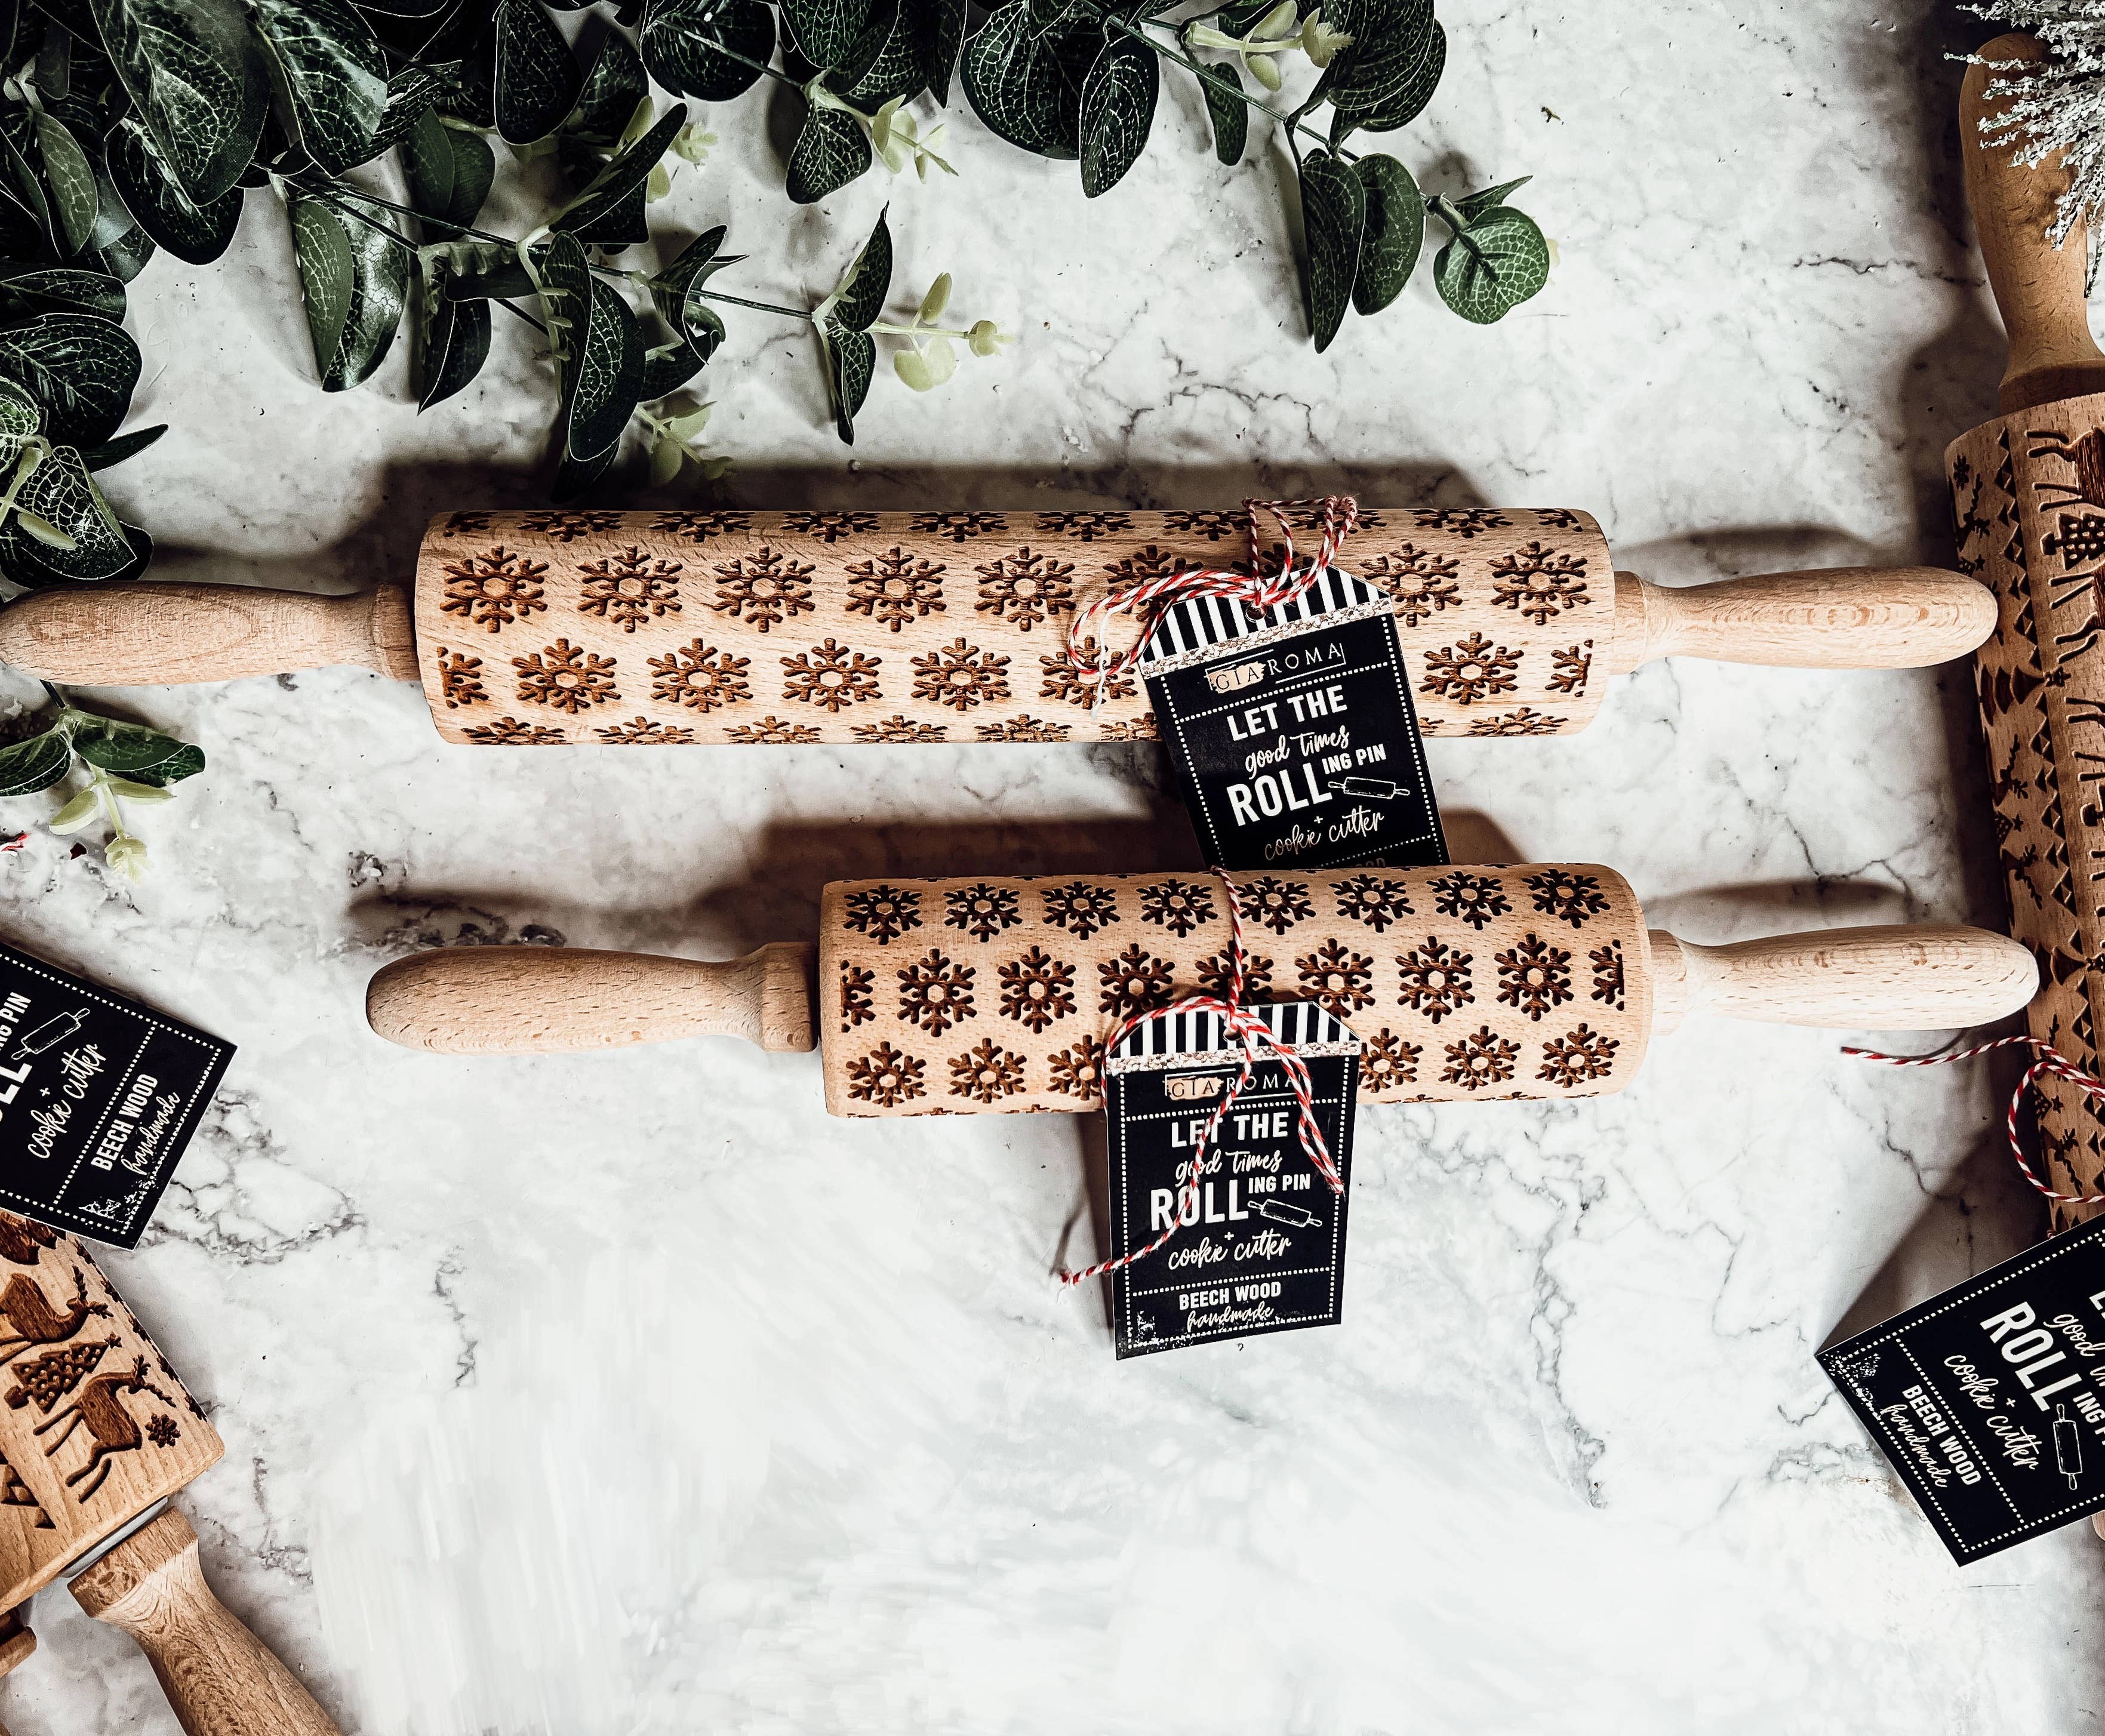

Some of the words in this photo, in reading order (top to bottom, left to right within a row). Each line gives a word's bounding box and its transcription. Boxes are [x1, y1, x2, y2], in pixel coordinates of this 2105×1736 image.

[1215, 643, 1342, 690] GIAROMA
[1227, 702, 1278, 741] LET
[1287, 685, 1347, 722] THE
[1245, 735, 1290, 780] good
[1290, 725, 1349, 756] times
[1356, 744, 1386, 765] PIN
[1265, 824, 1321, 860] cookie
[1329, 805, 1384, 842] cutter
[0, 992, 31, 1023] PIN
[28, 1100, 72, 1158] cookie
[61, 1044, 106, 1098] cutter
[91, 1119, 134, 1171] BEECH
[119, 1075, 158, 1118] WOOD
[121, 1092, 180, 1175] handmade
[1171, 1117, 1223, 1148] LET
[1233, 1112, 1288, 1140] THE
[1175, 1149, 1223, 1187] good
[1225, 1150, 1282, 1174] times
[1282, 1174, 1310, 1191] PIN
[1168, 1237, 1228, 1270] cookie
[1234, 1228, 1291, 1261] cutter
[1180, 1288, 1229, 1310] BEECH
[1235, 1282, 1281, 1301] WOOD
[1187, 1301, 1274, 1332] handmade
[1902, 1385, 1949, 1436] BEECH
[1940, 1436, 1981, 1485] WOOD
[1944, 1355, 1998, 1409] cookie
[1987, 1416, 2042, 1470] cutter
[1880, 1405, 1951, 1487] handmade
